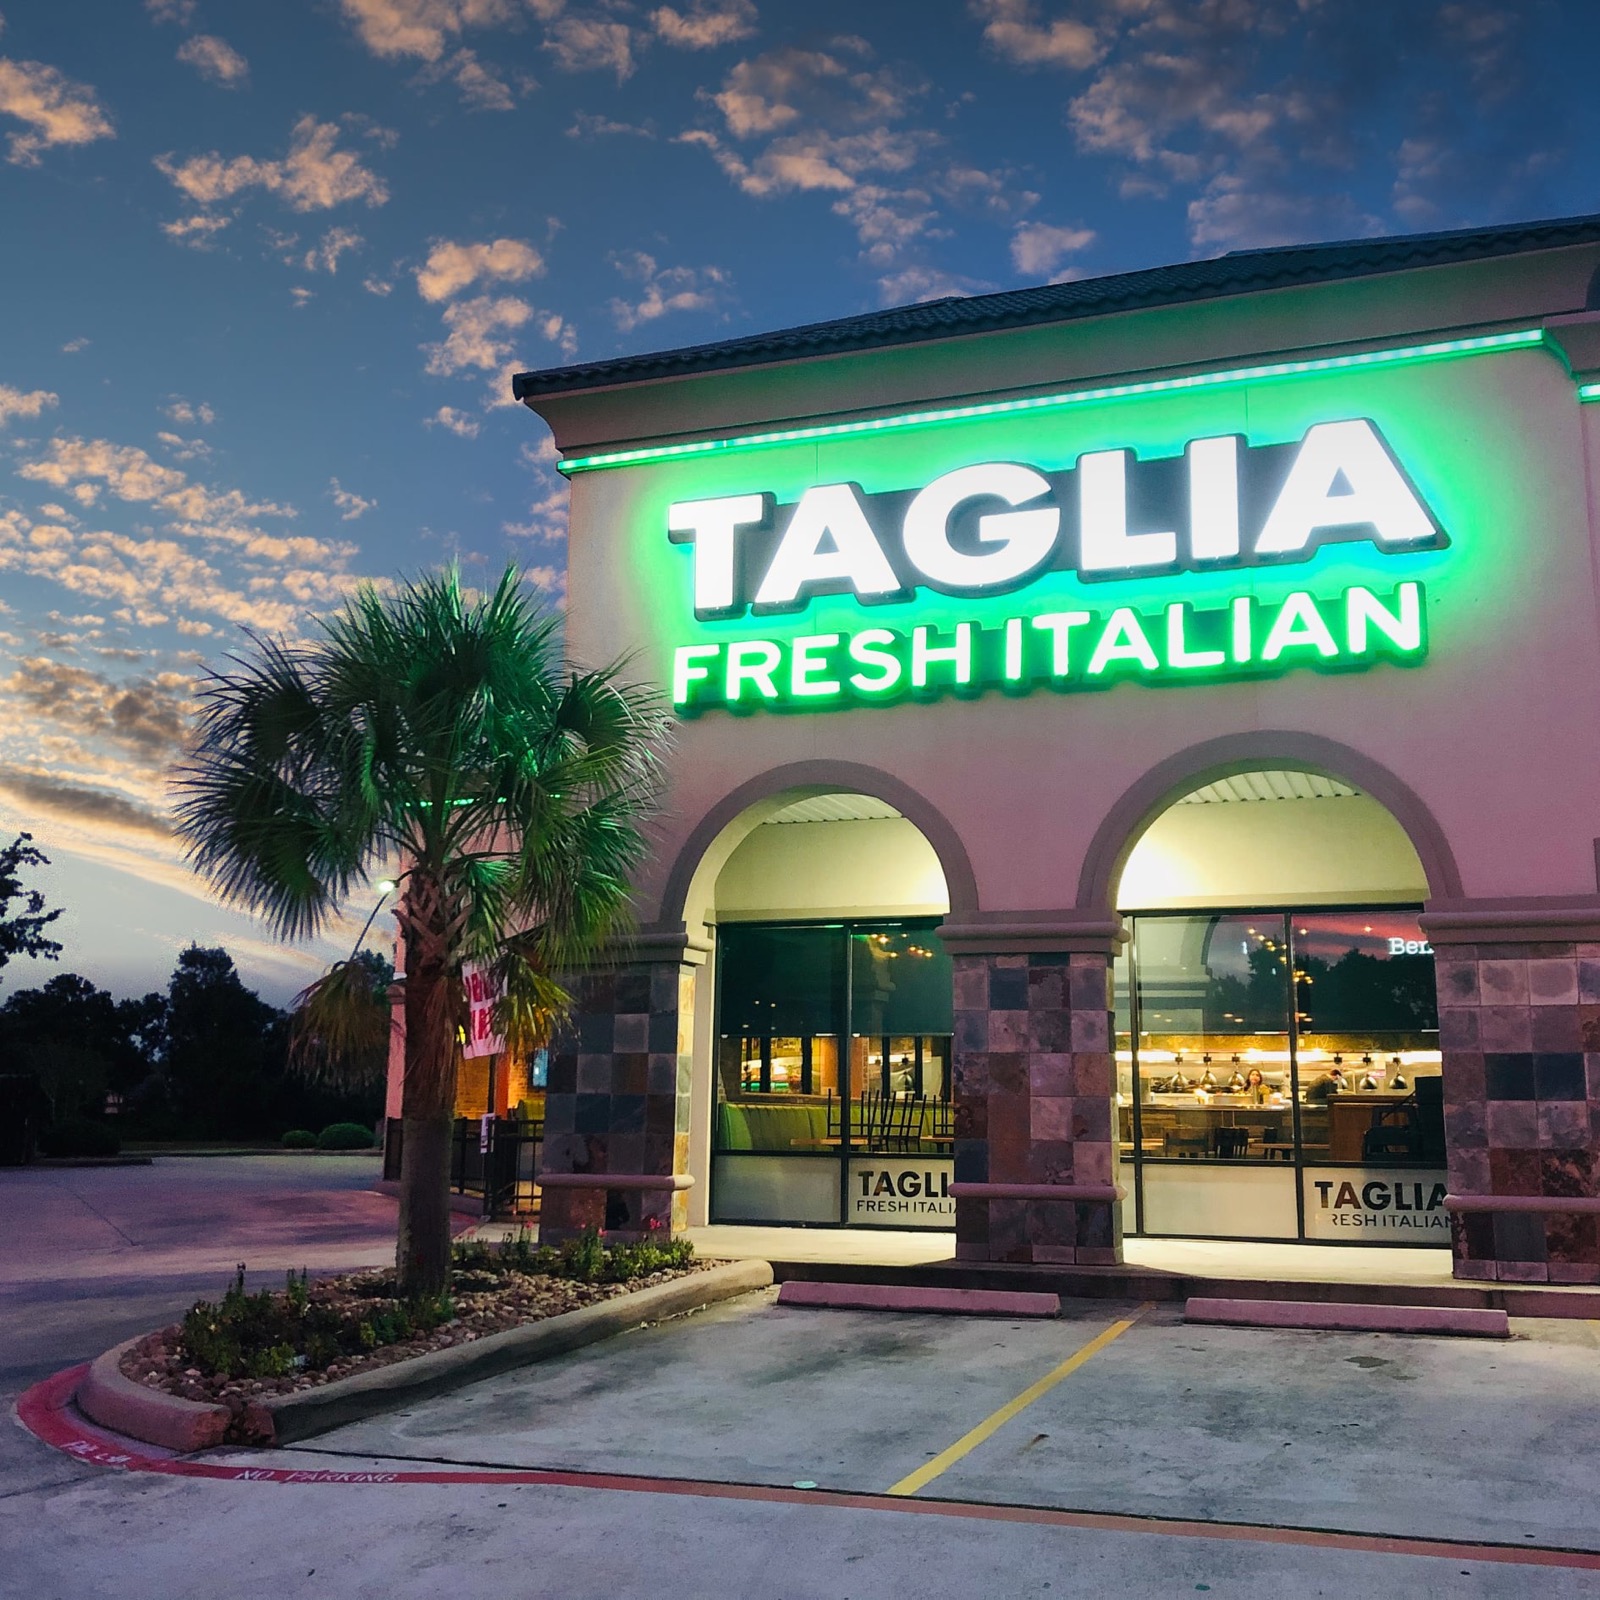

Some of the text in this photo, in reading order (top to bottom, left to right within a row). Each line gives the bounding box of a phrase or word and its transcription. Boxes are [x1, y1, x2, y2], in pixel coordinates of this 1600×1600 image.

[668, 417, 1438, 612] TAGLIA
[673, 582, 1422, 704] FRESH ITALIAN
[857, 1171, 948, 1198] TAGLI
[1314, 1181, 1448, 1211] TAGLIA
[857, 1200, 957, 1214] FRESH ITALI
[1331, 1213, 1377, 1227] RESH
[234, 1470, 399, 1483] NO PARKING
